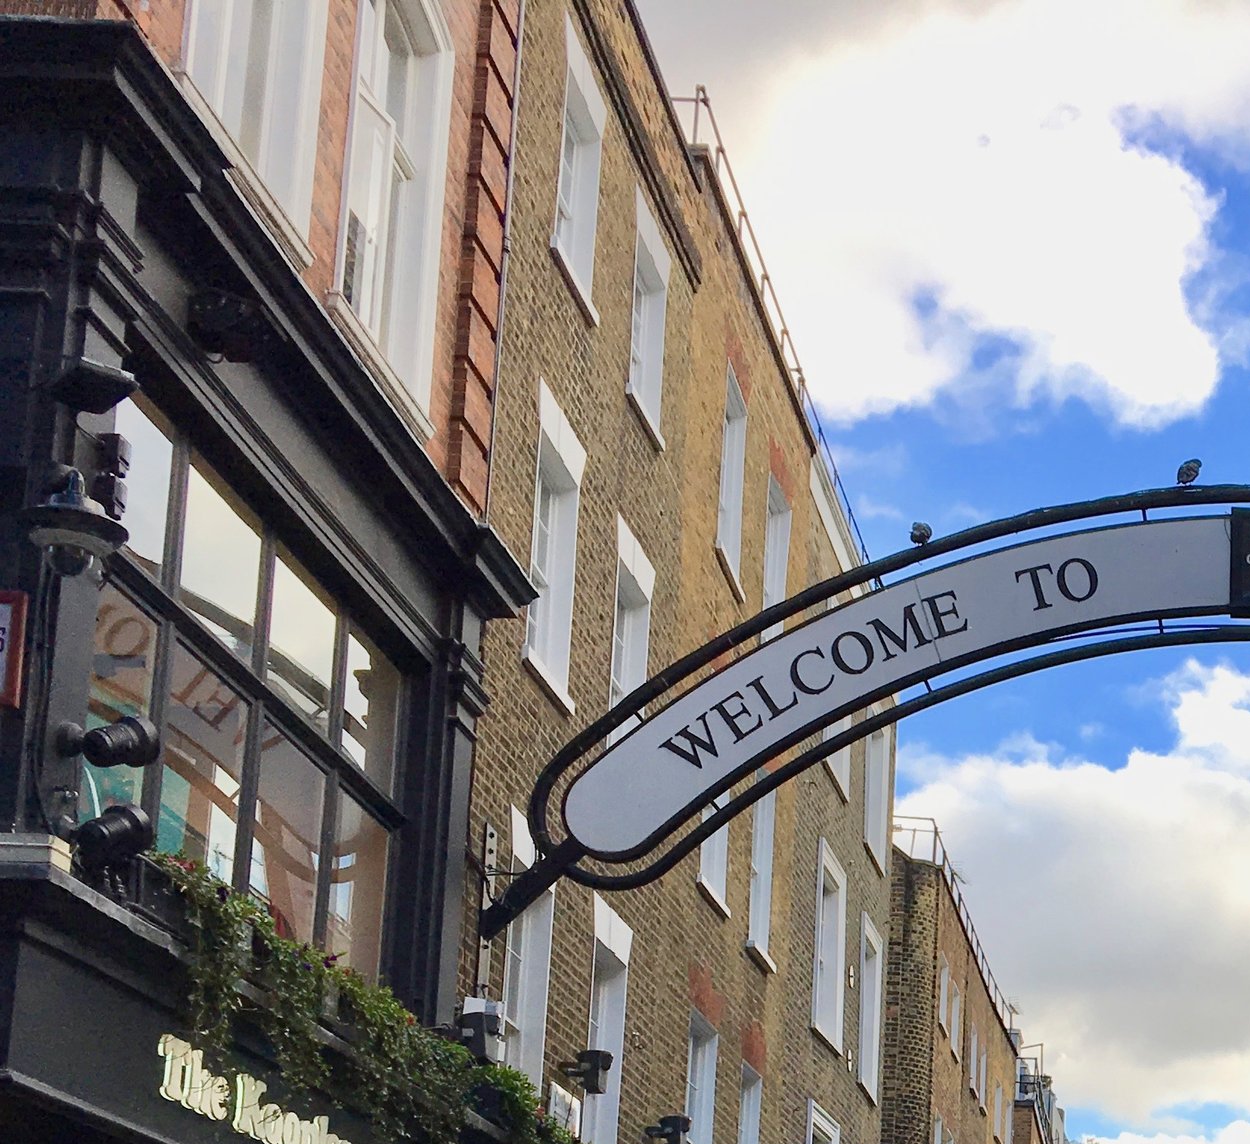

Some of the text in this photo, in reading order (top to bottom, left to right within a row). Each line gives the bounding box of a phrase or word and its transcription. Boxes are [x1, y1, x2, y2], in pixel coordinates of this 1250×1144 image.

[659, 558, 1099, 770] WELCOME TO
[158, 1033, 231, 1121] The
